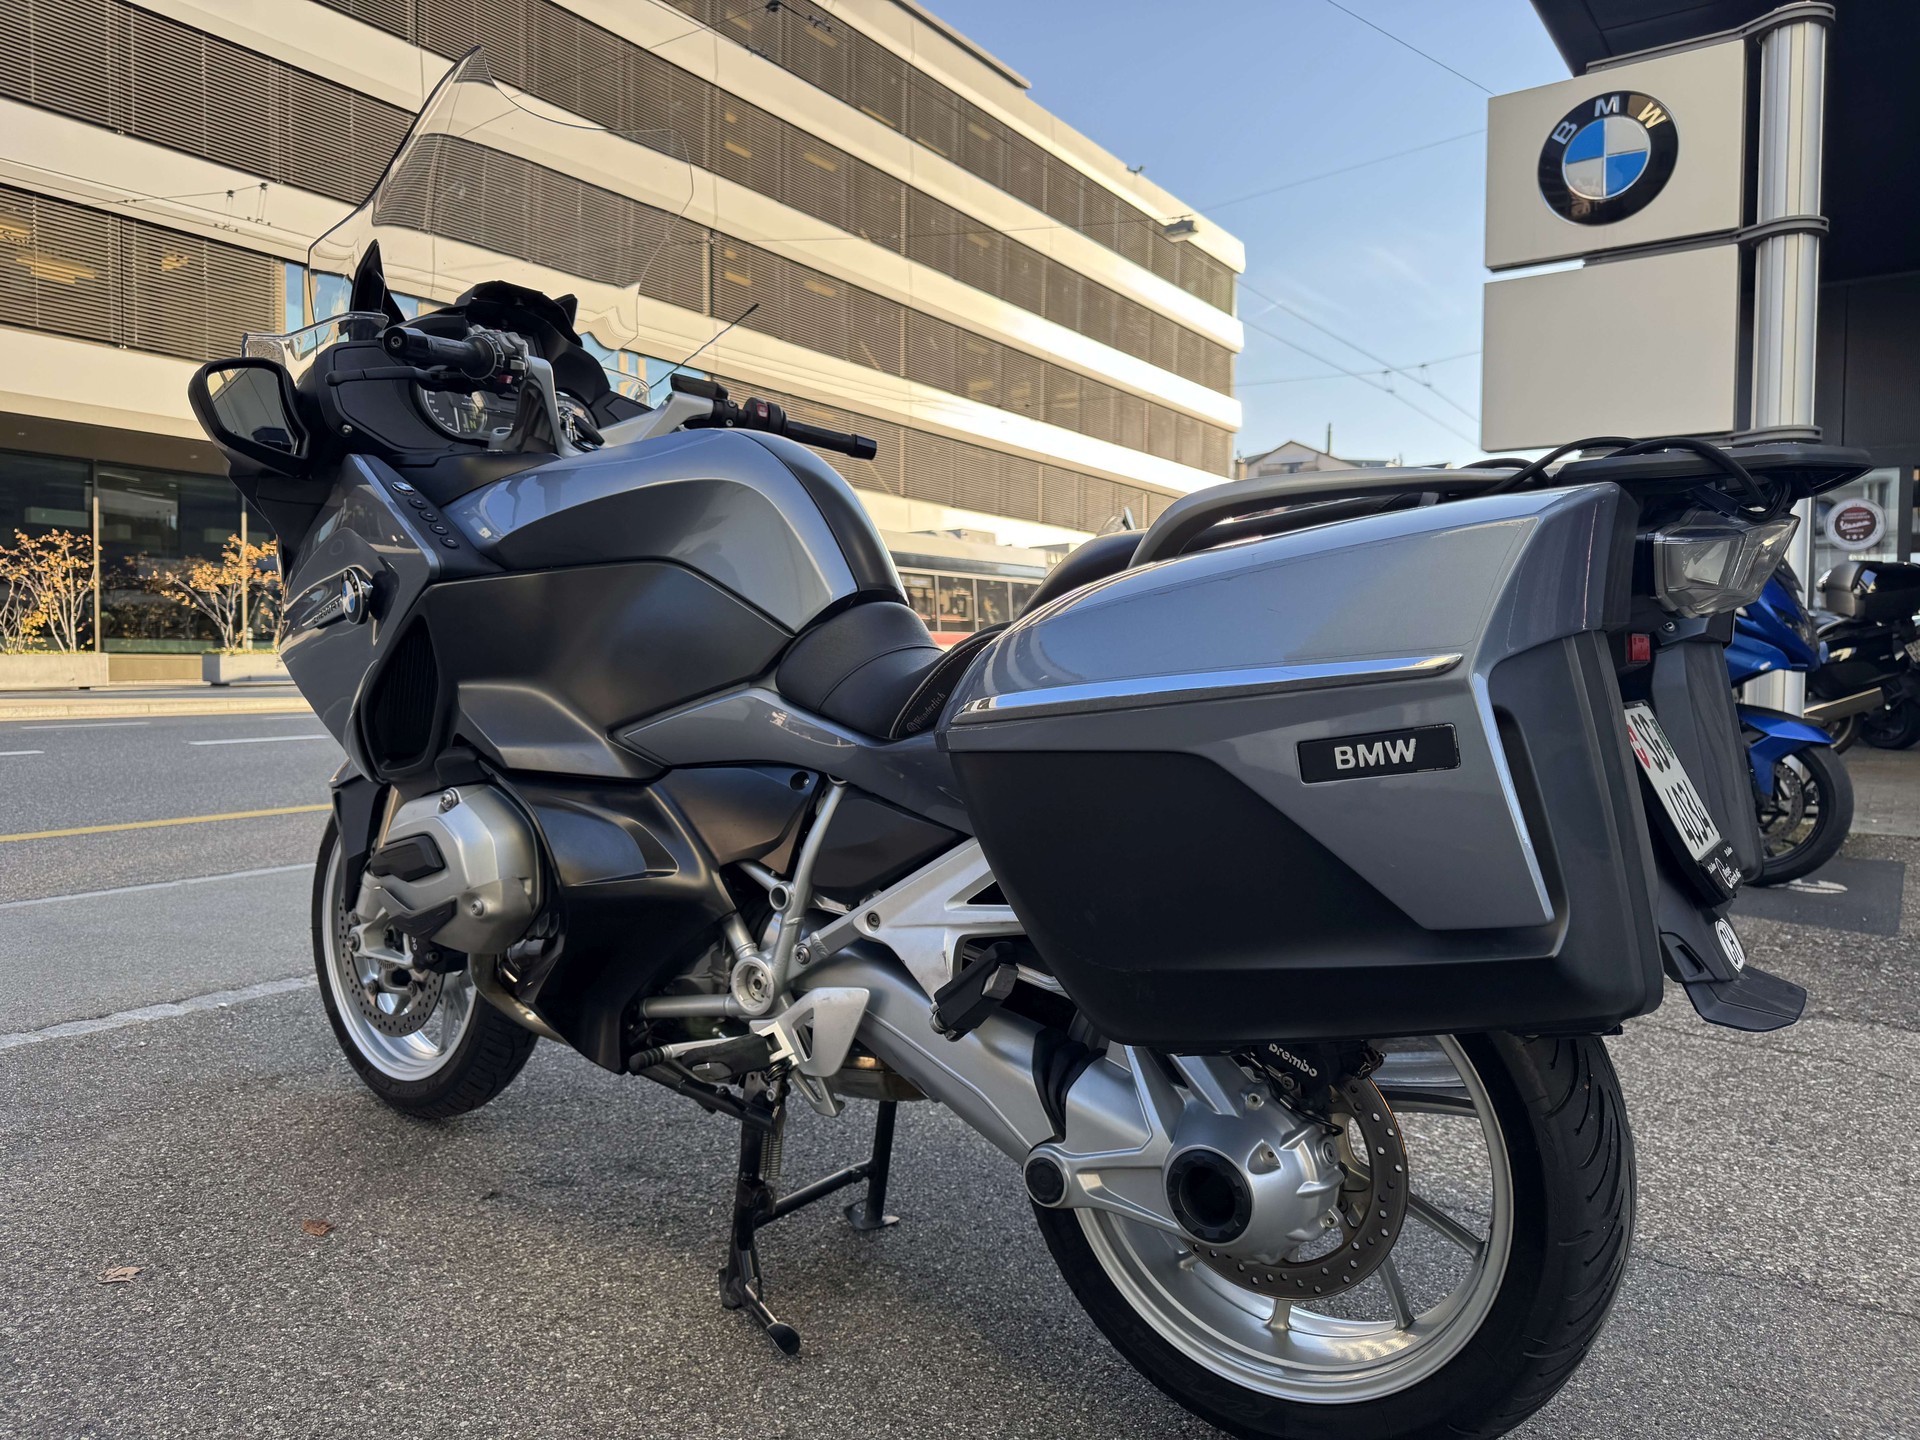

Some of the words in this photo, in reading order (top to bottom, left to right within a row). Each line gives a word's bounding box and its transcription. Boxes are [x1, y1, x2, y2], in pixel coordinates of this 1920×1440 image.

[1551, 95, 1667, 145] BMW
[1334, 738, 1416, 770] BMW
[1630, 713, 1671, 773] SG
[1665, 779, 1715, 850] 4034
[1719, 926, 1743, 965] CH
[1268, 1043, 1318, 1077] brembo
